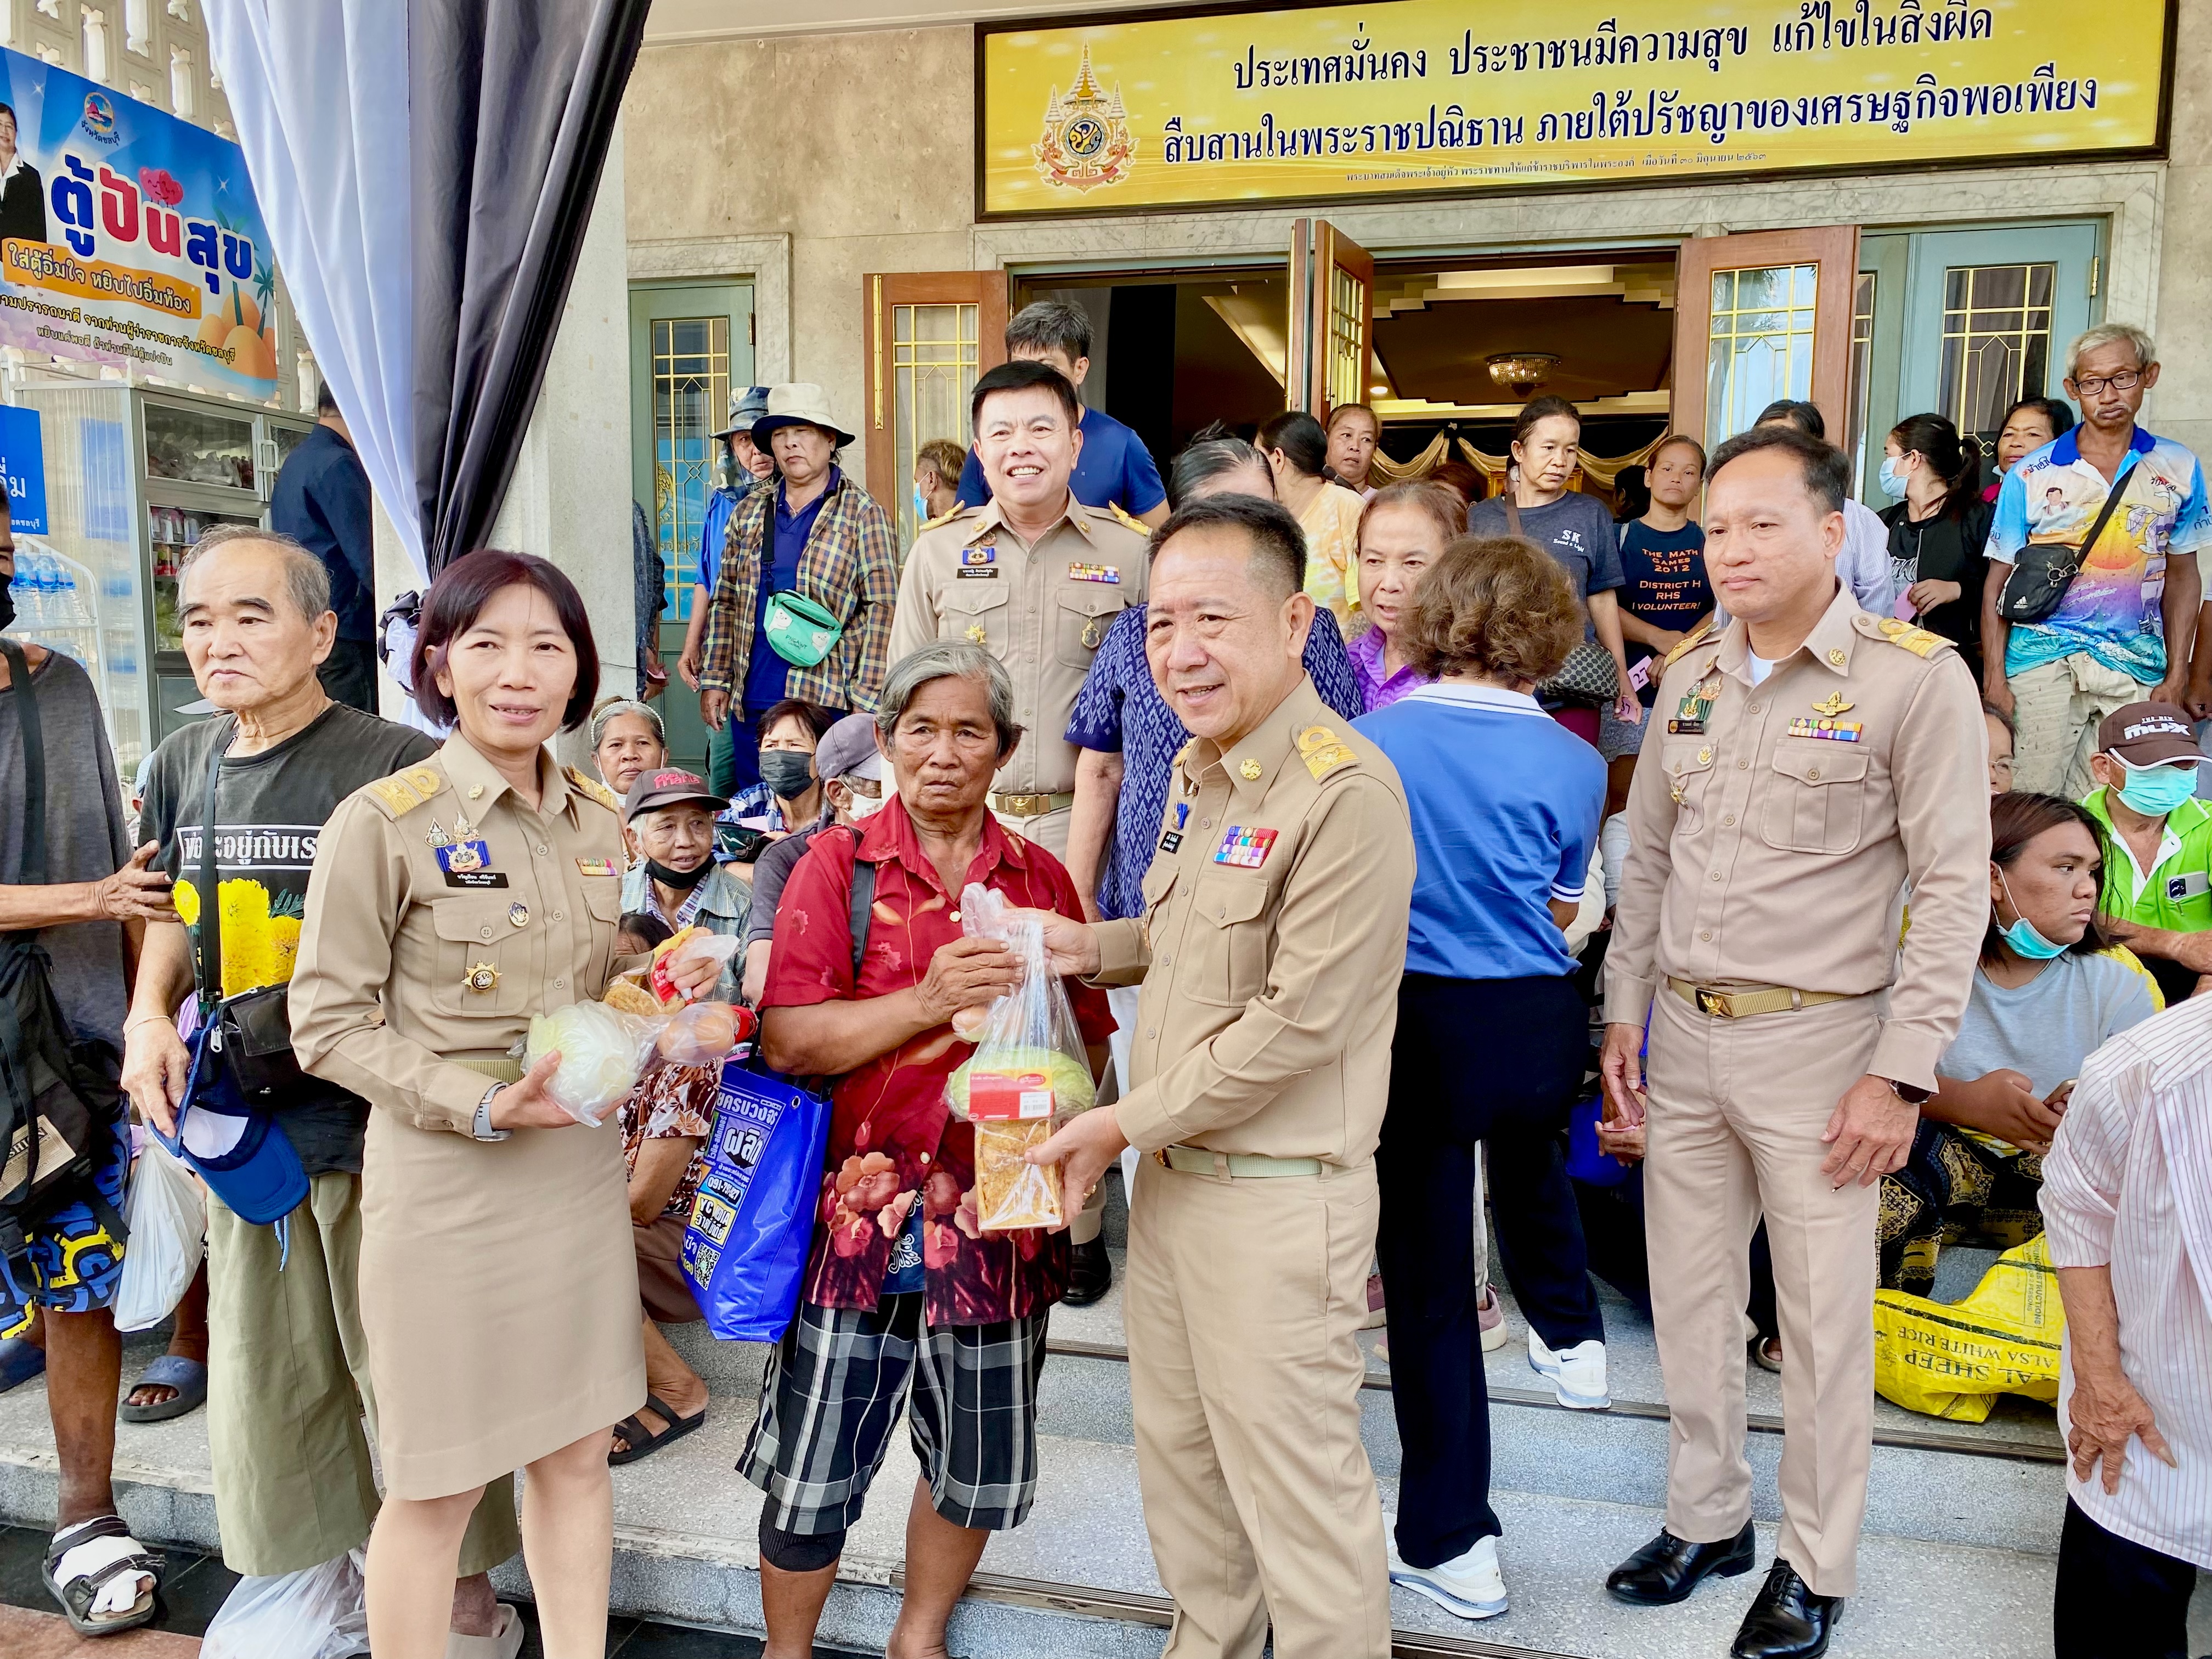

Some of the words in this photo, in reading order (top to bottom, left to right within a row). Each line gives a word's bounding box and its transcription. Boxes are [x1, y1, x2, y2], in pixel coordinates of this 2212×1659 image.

[1234, 22, 1426, 89] ประเทศมั่นคง
[1449, 18, 1748, 75] ประชาชนมีความสุข
[1773, 0, 1992, 52] แก้ไขในสิงผิด
[1164, 104, 1523, 163] สืบสานในพระราชปณิธาน
[1536, 61, 2098, 145] ภายใต้ปรัชญาของเศรษฐกิจพอเพียง
[8, 242, 86, 284] ใส่ตู้อิ่มใจ
[91, 270, 191, 313] หยิบไปอิ่มท้อง
[0, 294, 81, 323] ามปรารถนาดี
[1641, 549, 1663, 557] THE
[1669, 549, 1699, 558] MATH
[1652, 557, 1691, 566] GAMES
[1654, 565, 1690, 573] 2012
[1639, 580, 1689, 589] DISTRICT
[1656, 591, 1680, 600] RHS
[1897, 1325, 1937, 1347] RICE
[1939, 1338, 2001, 1361] WHITE
[1904, 1348, 1990, 1382] SHEEP
